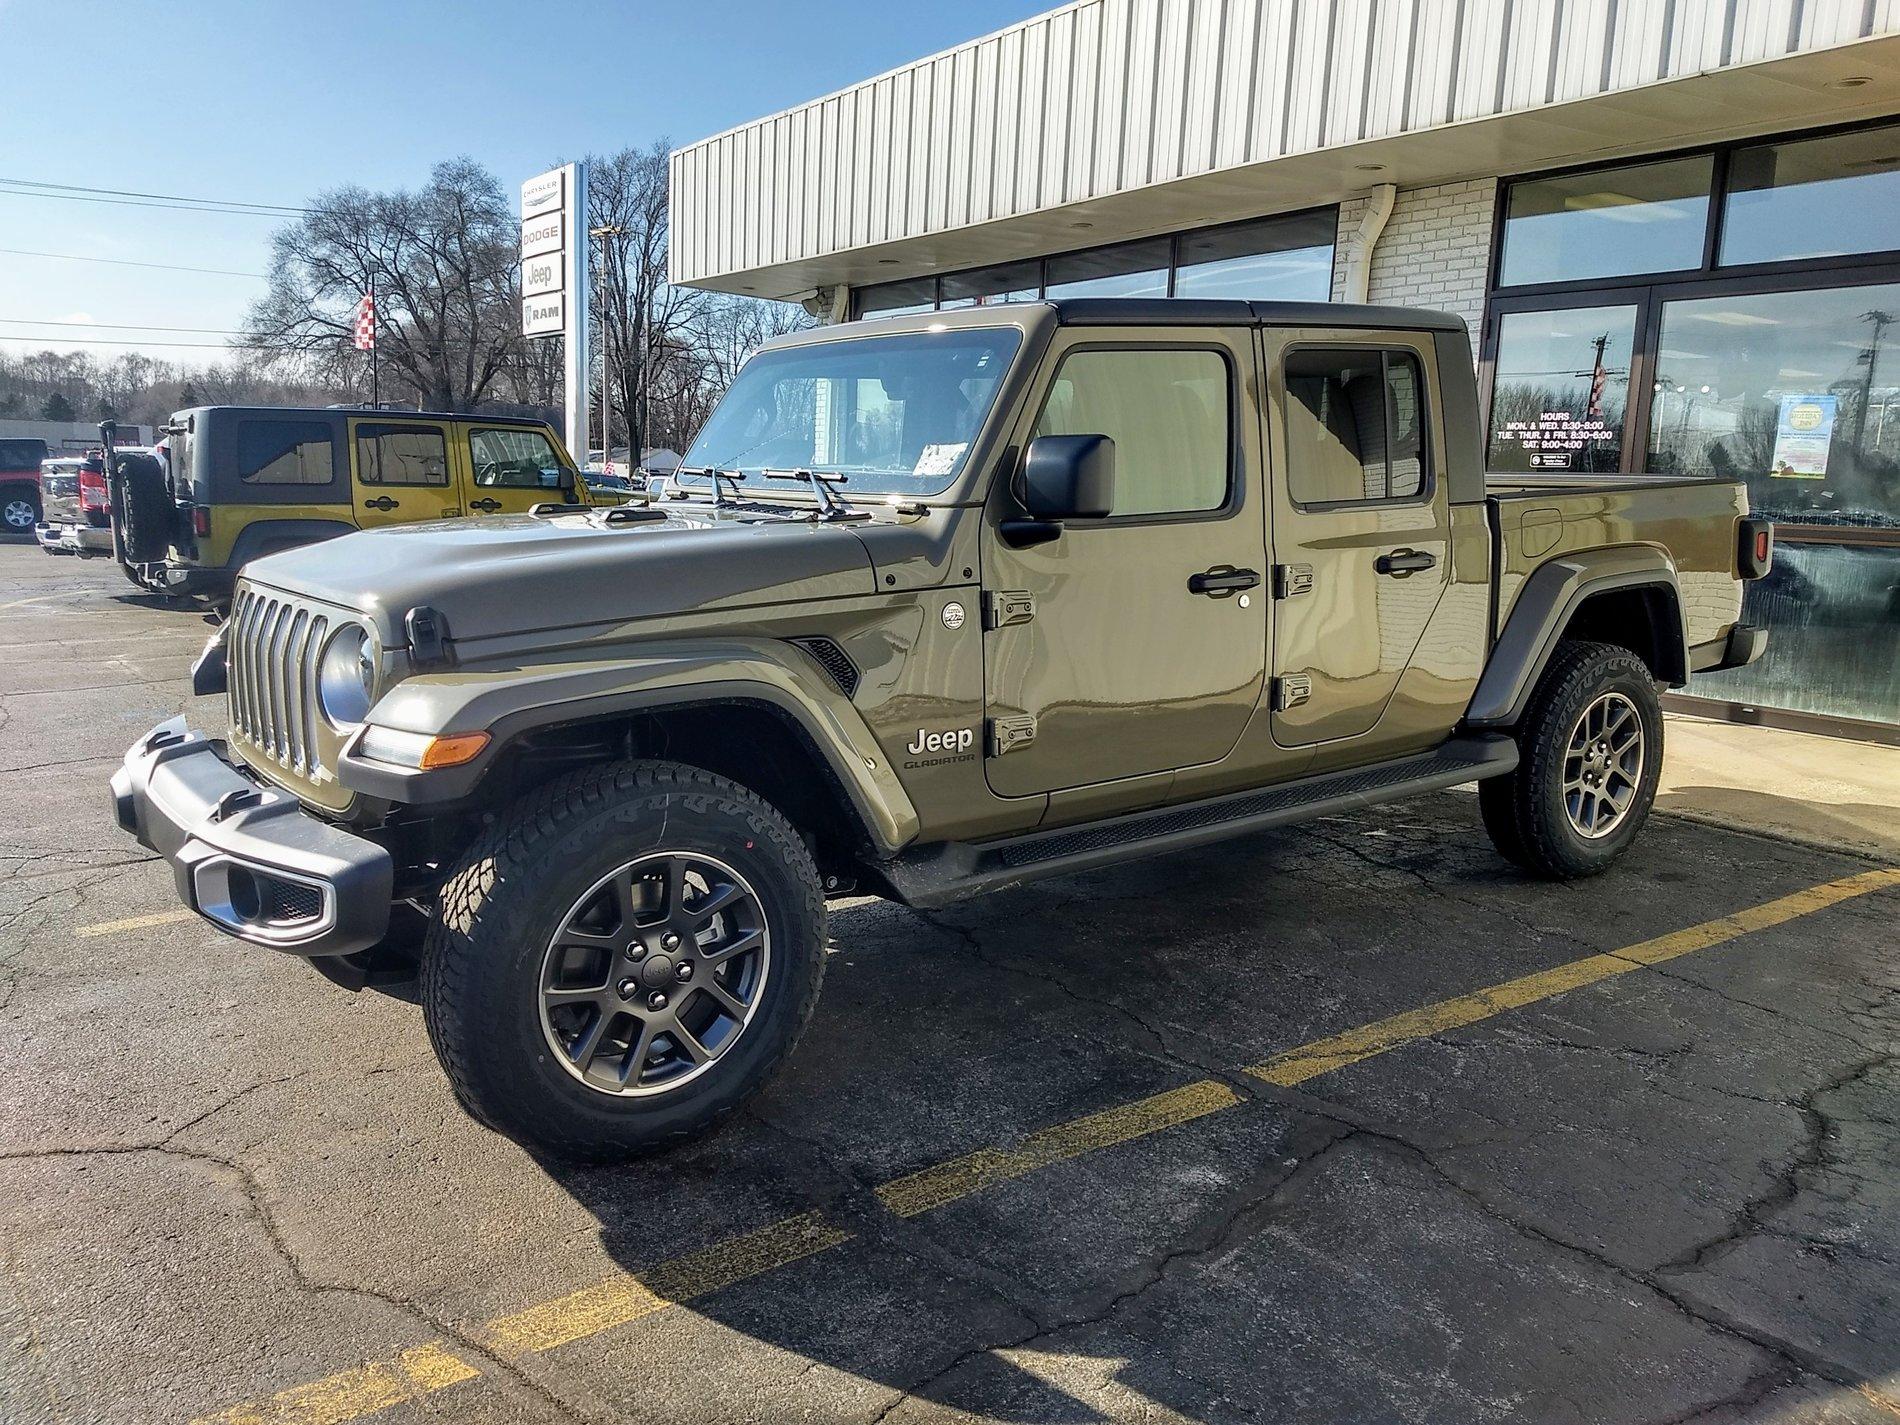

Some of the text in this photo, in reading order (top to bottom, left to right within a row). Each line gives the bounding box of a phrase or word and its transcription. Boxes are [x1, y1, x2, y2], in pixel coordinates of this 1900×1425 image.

[523, 181, 557, 198] CHRYSLER
[523, 226, 558, 245] DODGE
[528, 264, 552, 286] Jeep
[533, 306, 559, 320] RAM
[1540, 412, 1570, 421] HOURS
[1506, 421, 1528, 430] MON.
[1529, 421, 1536, 430] &
[1539, 421, 1560, 430] WED.
[1497, 431, 1515, 440] TUE.
[1519, 431, 1541, 440] THUR.
[1543, 431, 1550, 440] &
[1522, 440, 1539, 449] SAT.
[907, 727, 974, 755] Jeep
[903, 754, 976, 769] GLADIATOR
